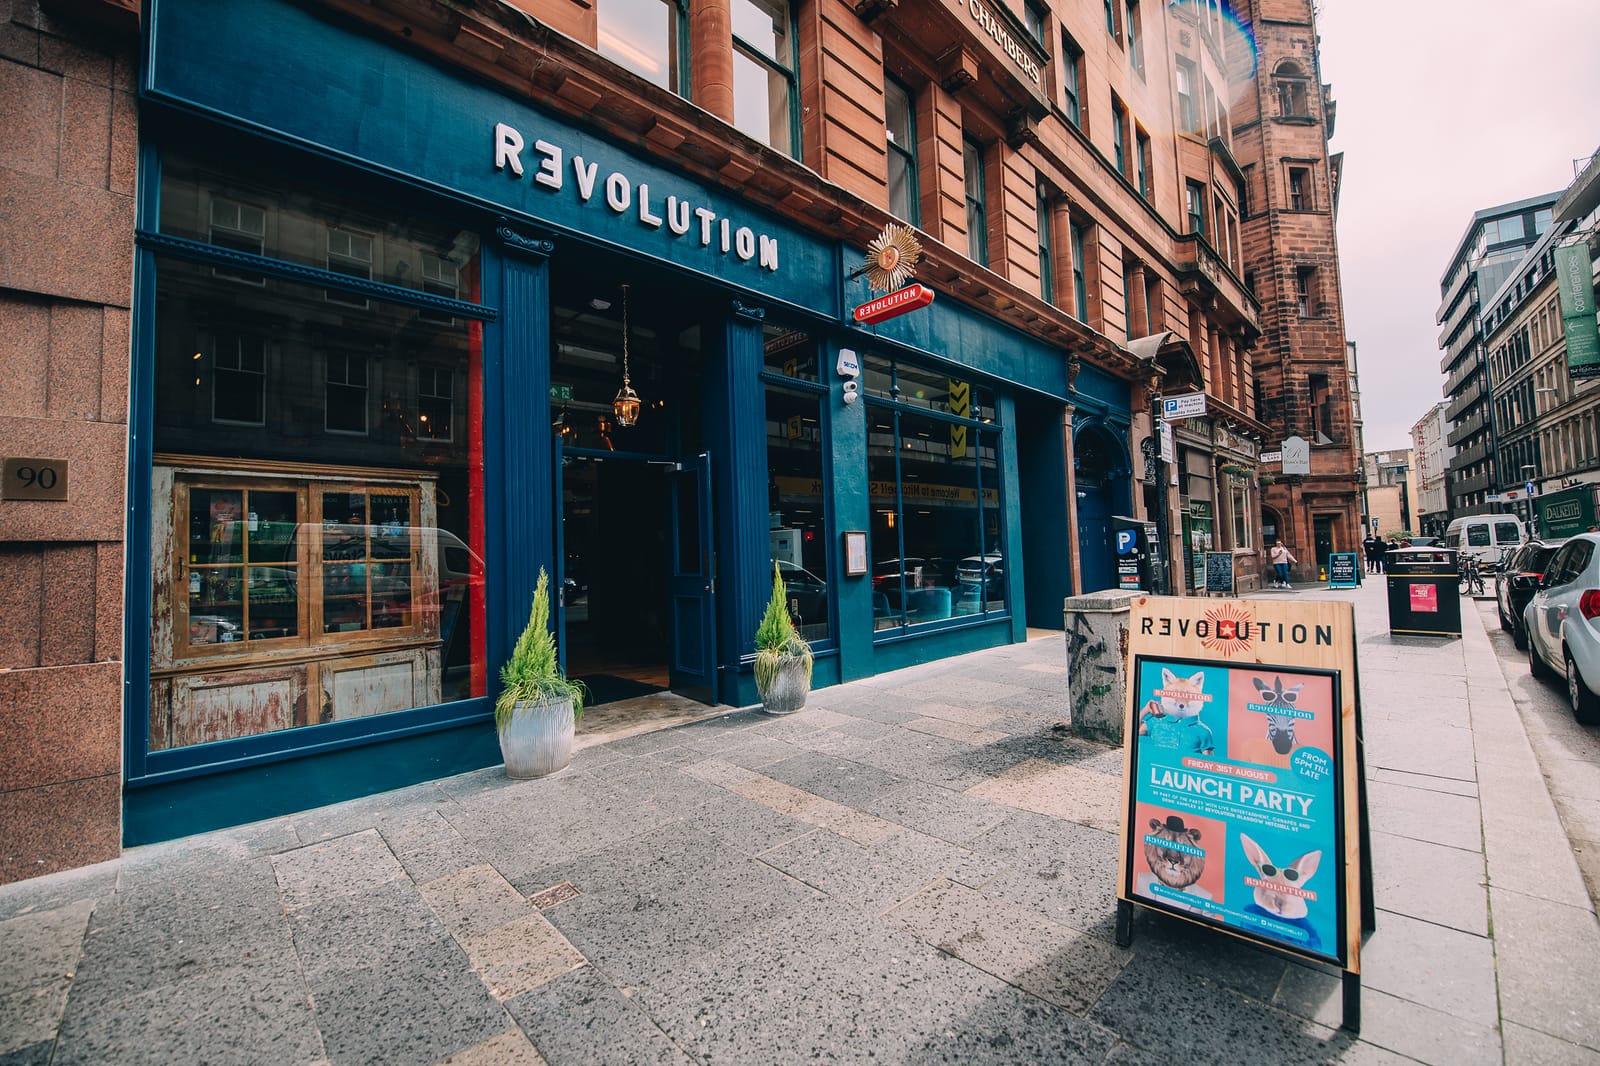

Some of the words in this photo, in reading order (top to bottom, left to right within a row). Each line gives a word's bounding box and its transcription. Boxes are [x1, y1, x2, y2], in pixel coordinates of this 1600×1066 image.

[969, 0, 1039, 84] CHAMBERS
[494, 121, 778, 272] REVOLUTION
[1568, 255, 1585, 312] conferences
[859, 288, 916, 317] REVOLUTION
[16, 466, 57, 490] 90
[1546, 502, 1580, 520] DALKEITH
[1141, 617, 1332, 646] REVOLUTION
[1187, 759, 1214, 770] FRIDAY
[1235, 767, 1270, 781] AUGUST
[1294, 757, 1313, 769] 5PM
[1314, 763, 1329, 776] TILL
[1302, 751, 1328, 766] FROM
[1300, 767, 1320, 781] LATE
[1151, 767, 1233, 801] LAUNCH
[1240, 785, 1313, 816] PARTY
